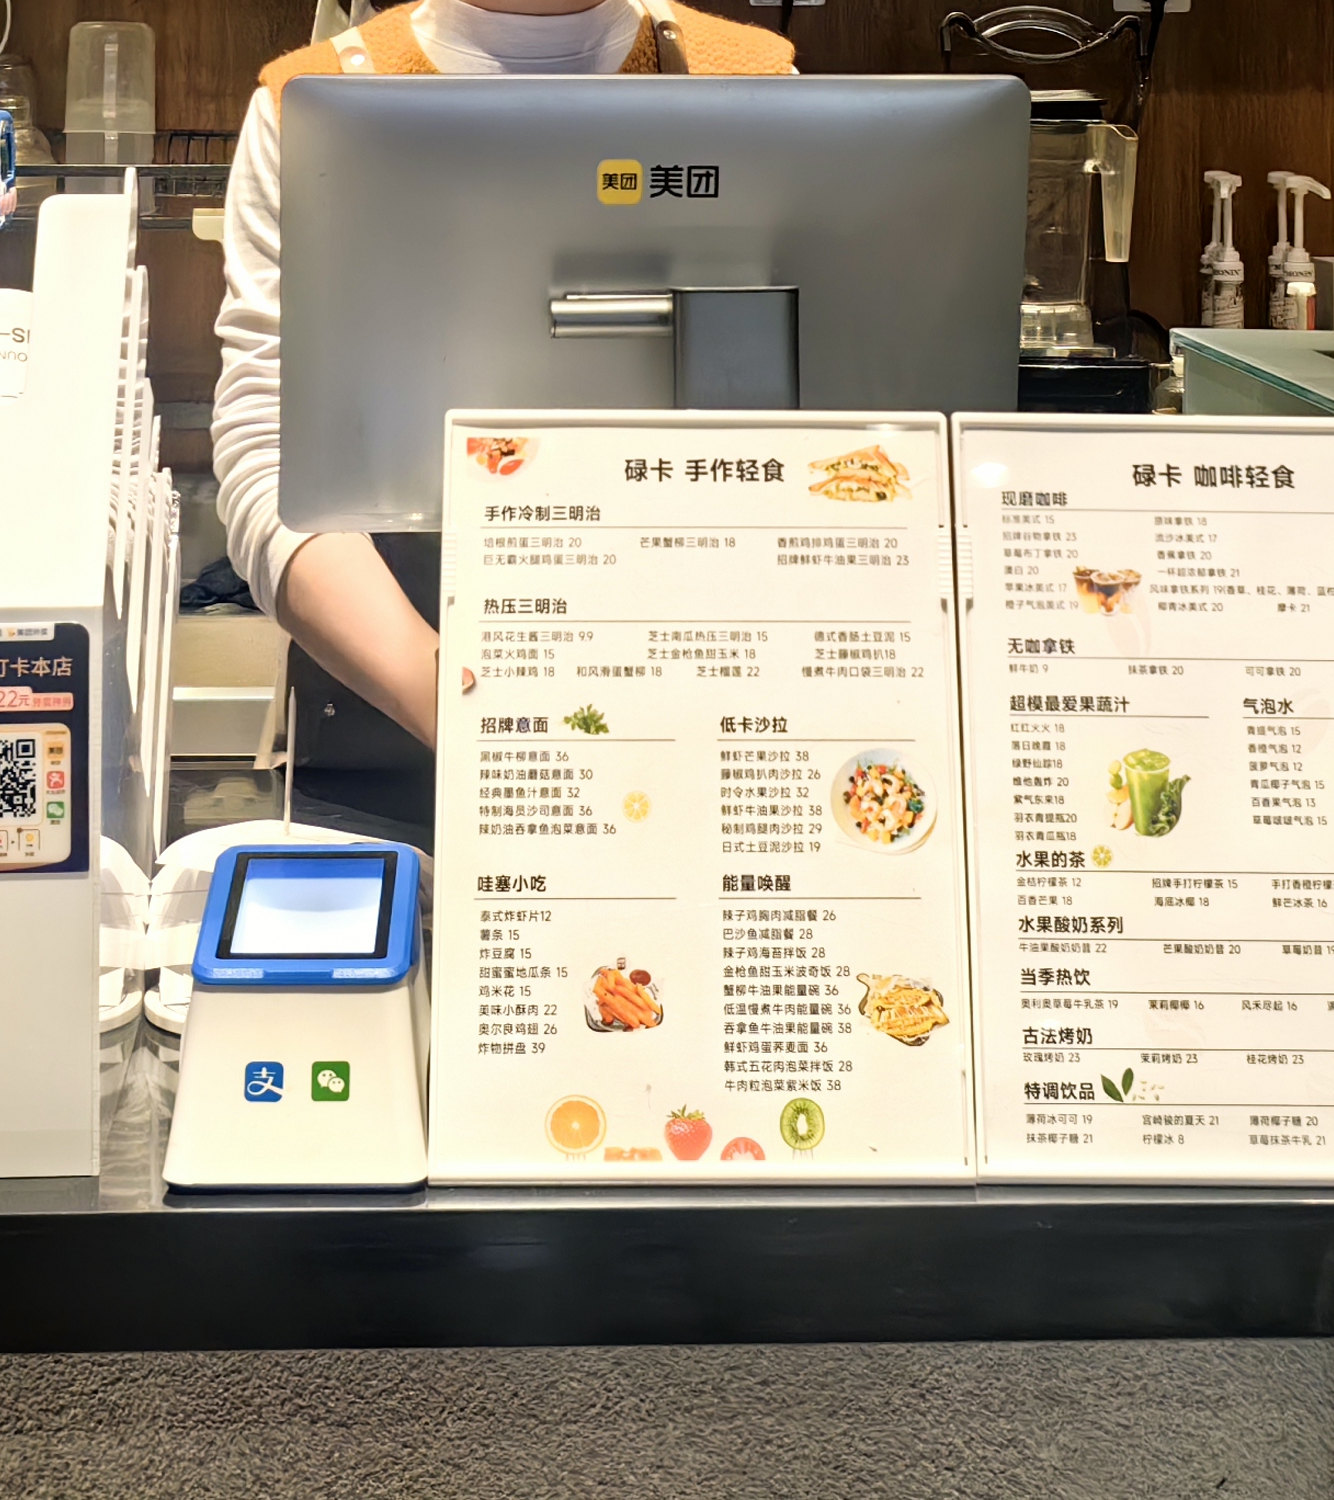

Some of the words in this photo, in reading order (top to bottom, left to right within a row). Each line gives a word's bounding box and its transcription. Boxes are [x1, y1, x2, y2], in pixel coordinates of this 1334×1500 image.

[602, 173, 637, 190] 美团
[650, 165, 719, 198] 美团
[624, 457, 674, 483] 碌卡
[684, 457, 785, 483] 手作轻食
[1131, 463, 1183, 488] 碌卡
[1193, 464, 1296, 489] 咖啡轻食
[1001, 490, 1068, 507] 现磨咖啡
[484, 505, 601, 522] 手作冷制三明治
[484, 598, 568, 615] 热压三明治
[578, 630, 594, 642] 9.9
[756, 630, 769, 643] 15
[1007, 637, 1076, 655] 无咖拿铁
[744, 648, 757, 660] 18
[543, 666, 555, 678] 18
[650, 665, 663, 678] 18
[1009, 694, 1130, 713] 超模最爱果蔬汁
[1242, 697, 1295, 715] 气泡水
[480, 716, 549, 734] 招牌意面
[719, 716, 788, 734] 低卡沙拉
[555, 750, 570, 762] 36
[795, 750, 810, 762] 38
[579, 768, 594, 781] 30
[807, 768, 822, 780] 26
[566, 786, 581, 799] 32
[720, 786, 792, 799] 时令水果沙拉
[796, 786, 810, 799] 32
[578, 805, 593, 817] 36
[720, 804, 803, 817] 鲜虾牛油果沙拉
[808, 804, 823, 817] 38
[602, 823, 617, 835] 36
[808, 822, 823, 835] 29
[722, 840, 805, 854] 日式土豆泥沙拉
[809, 841, 822, 853] 19
[1015, 850, 1086, 869] 水果的茶
[477, 874, 547, 893] 哇塞小吃
[722, 874, 792, 892] 能量唤醒
[1227, 878, 1239, 889] 15
[822, 909, 837, 922] 26
[1018, 915, 1124, 934] 水果酸奶系列
[480, 928, 504, 942] 薯条
[508, 929, 520, 941] 15
[799, 928, 814, 940] 28
[479, 947, 516, 960] 炸豆腐
[520, 947, 532, 960] 15
[811, 946, 826, 959] 28
[1228, 944, 1242, 955] 20
[479, 965, 552, 979] 甜蜜蜜地瓜条
[556, 966, 569, 978] 15
[723, 964, 832, 978] 金枪鱼甜玉米波奇饭
[835, 965, 851, 978] 28
[1020, 967, 1091, 986] 当季热饮
[478, 985, 515, 998] 鸡米花
[519, 985, 532, 997] 15
[824, 984, 840, 996] 36
[479, 1003, 539, 1017] 美味小酥肉
[543, 1003, 558, 1016] 22
[723, 1002, 833, 1016] 低温慢煮牛肉能量碗
[837, 1002, 852, 1016] 36
[1107, 999, 1119, 1009] 19
[543, 1023, 558, 1035] 26
[723, 1021, 834, 1035] 吞拿鱼牛油果能量碗
[837, 1022, 853, 1034] 38
[1021, 1026, 1093, 1045] 古法烤奶
[478, 1041, 527, 1055] 炸物拼盘
[531, 1042, 546, 1054] 39
[813, 1041, 828, 1053] 36
[1068, 1052, 1081, 1063] 23
[838, 1060, 853, 1073] 28
[826, 1079, 842, 1091] 38
[1023, 1081, 1096, 1101] 特调饮品
[1208, 1115, 1220, 1126] 21
[1177, 1133, 1185, 1145] 8
